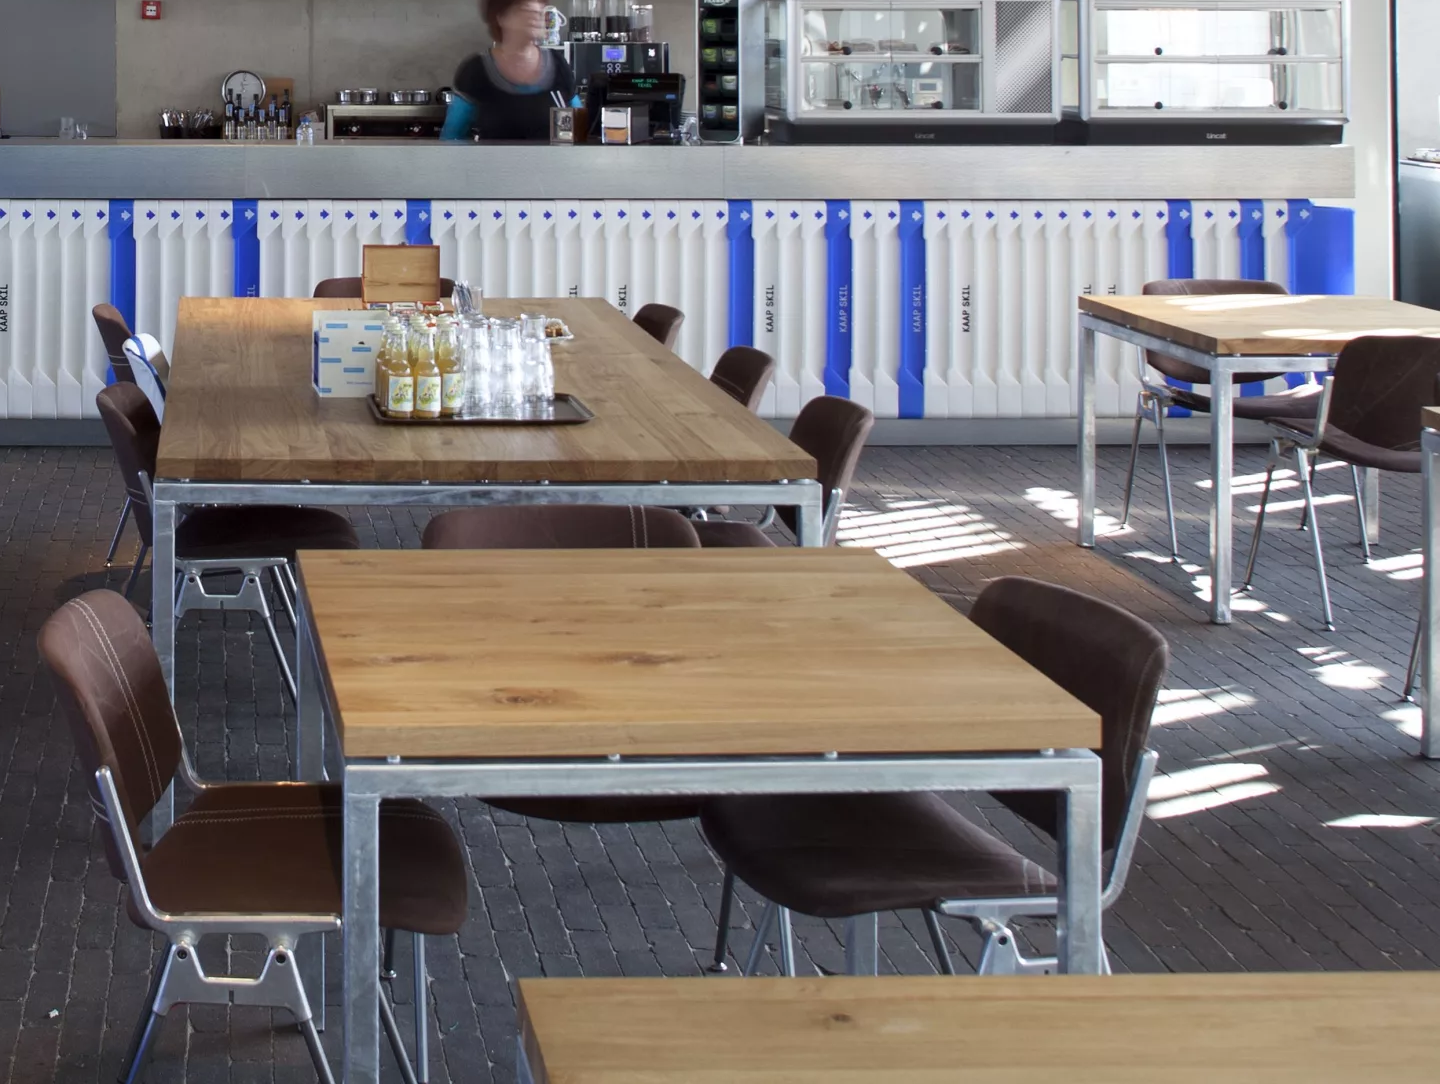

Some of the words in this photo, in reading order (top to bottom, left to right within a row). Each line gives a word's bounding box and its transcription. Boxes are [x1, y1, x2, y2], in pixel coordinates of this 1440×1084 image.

[0, 284, 8, 307] SKIL
[765, 284, 774, 307] SKIL
[839, 284, 848, 307] SKIL
[912, 284, 921, 307] SKIL
[962, 284, 971, 307] SKIL
[0, 309, 8, 332] KAAP
[765, 309, 774, 333] KAAP
[839, 309, 847, 333] KAAP
[912, 309, 921, 333] KAAP
[962, 309, 970, 333] KAAP
